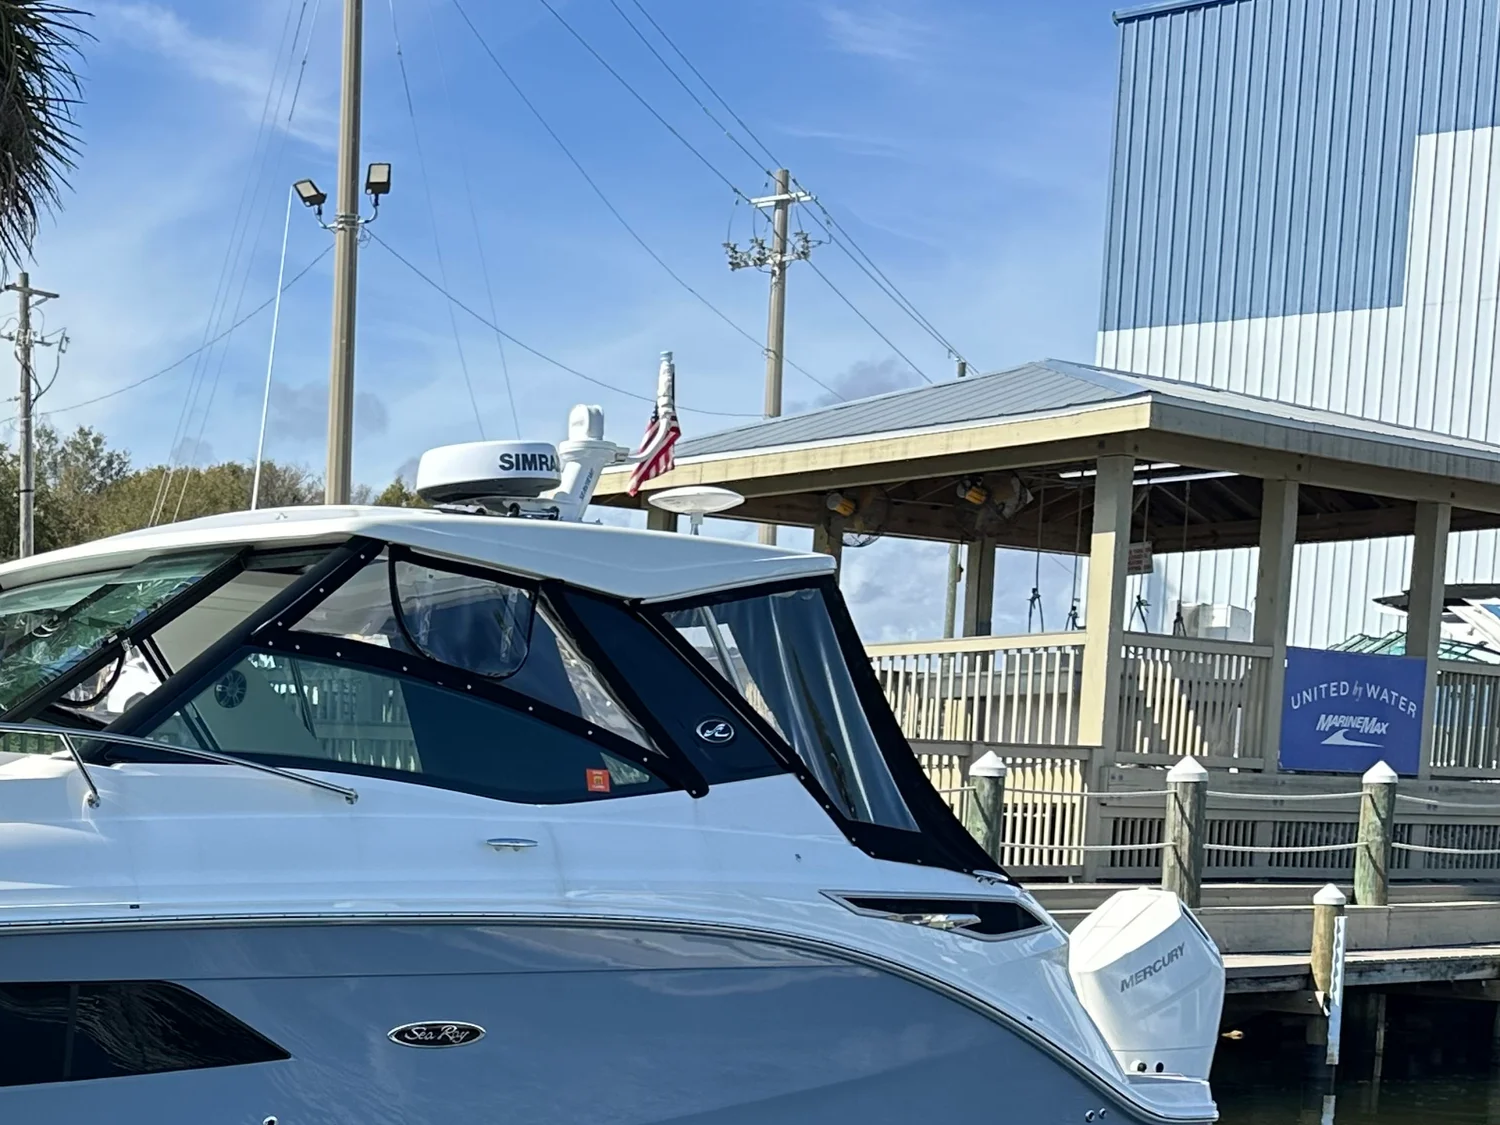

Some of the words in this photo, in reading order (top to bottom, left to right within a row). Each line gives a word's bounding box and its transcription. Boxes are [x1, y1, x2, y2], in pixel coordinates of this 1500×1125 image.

[1291, 681, 1350, 710] UNITED
[1352, 680, 1363, 702] by
[1365, 682, 1418, 719] WATER
[1120, 941, 1185, 993] MERCURY
[404, 1026, 435, 1041] Sea
[436, 1024, 470, 1044] Ray
